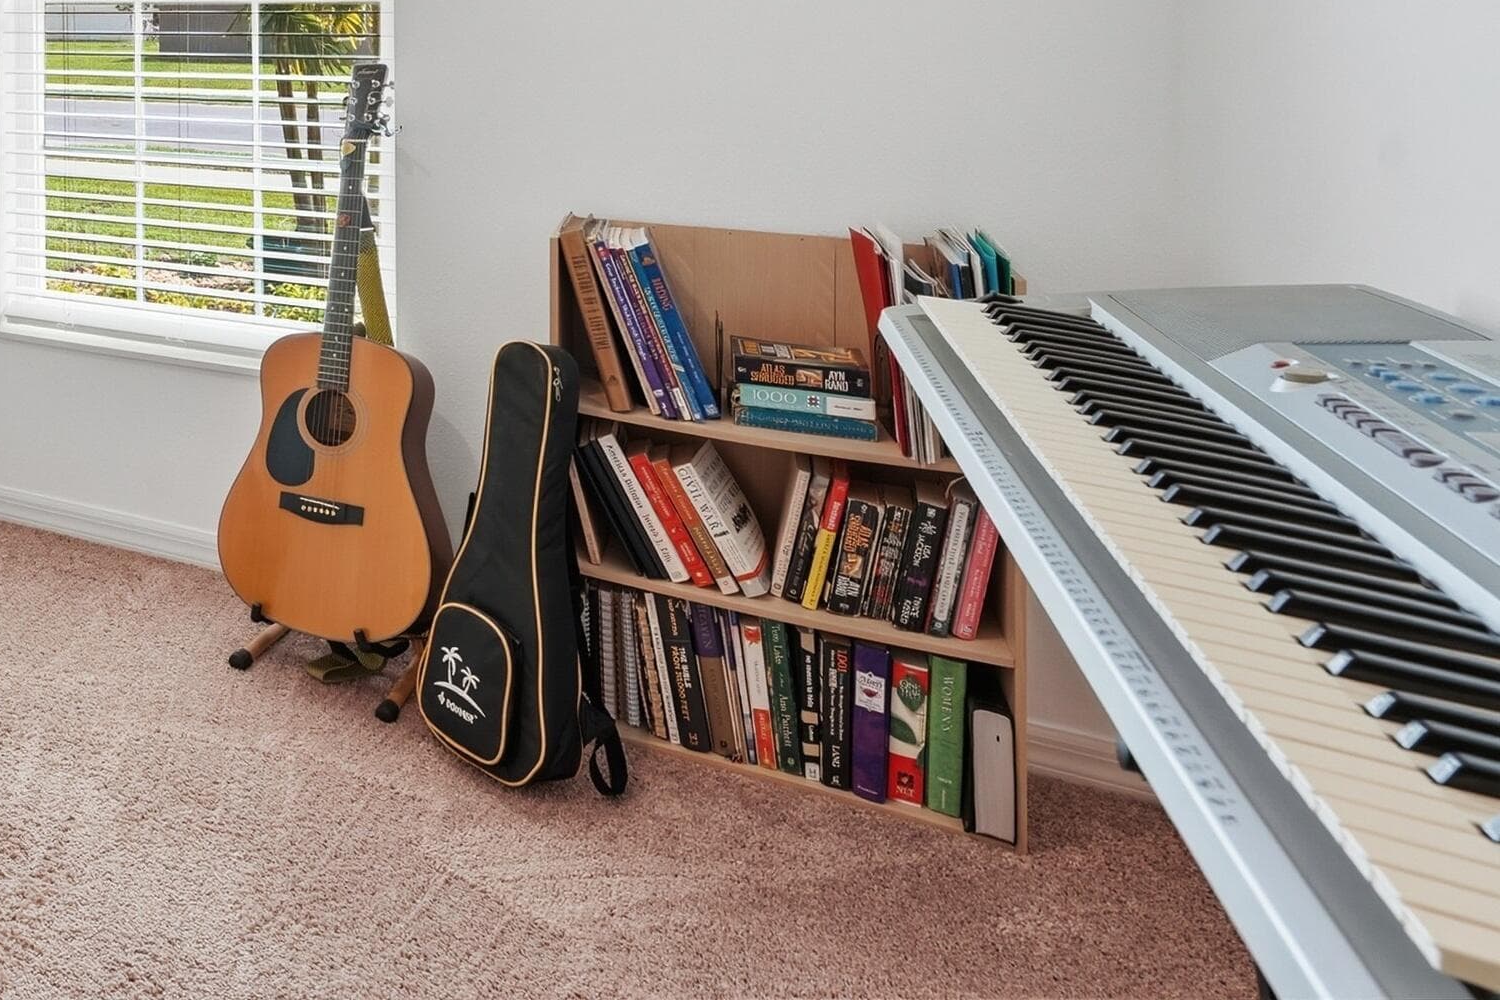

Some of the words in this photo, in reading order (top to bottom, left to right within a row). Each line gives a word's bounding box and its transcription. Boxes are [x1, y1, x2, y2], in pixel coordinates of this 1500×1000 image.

[760, 363, 785, 374] ATLAS
[828, 370, 846, 381] AYN
[750, 371, 794, 385] SHRUGGED
[825, 379, 849, 392] RAND
[752, 389, 797, 404] 1000
[678, 467, 702, 502] CIVIL
[699, 502, 720, 531] WAR
[913, 534, 925, 567] JACKSON
[922, 544, 932, 560] LISA
[771, 625, 780, 642] Tom
[678, 646, 687, 662] THE
[773, 644, 784, 664] Lake
[670, 645, 680, 670] FROM
[679, 699, 689, 721] FEET
[681, 664, 691, 688] BIBLE
[779, 694, 789, 711] Ann
[781, 713, 793, 747] Patchett
[831, 745, 839, 767] LANG
